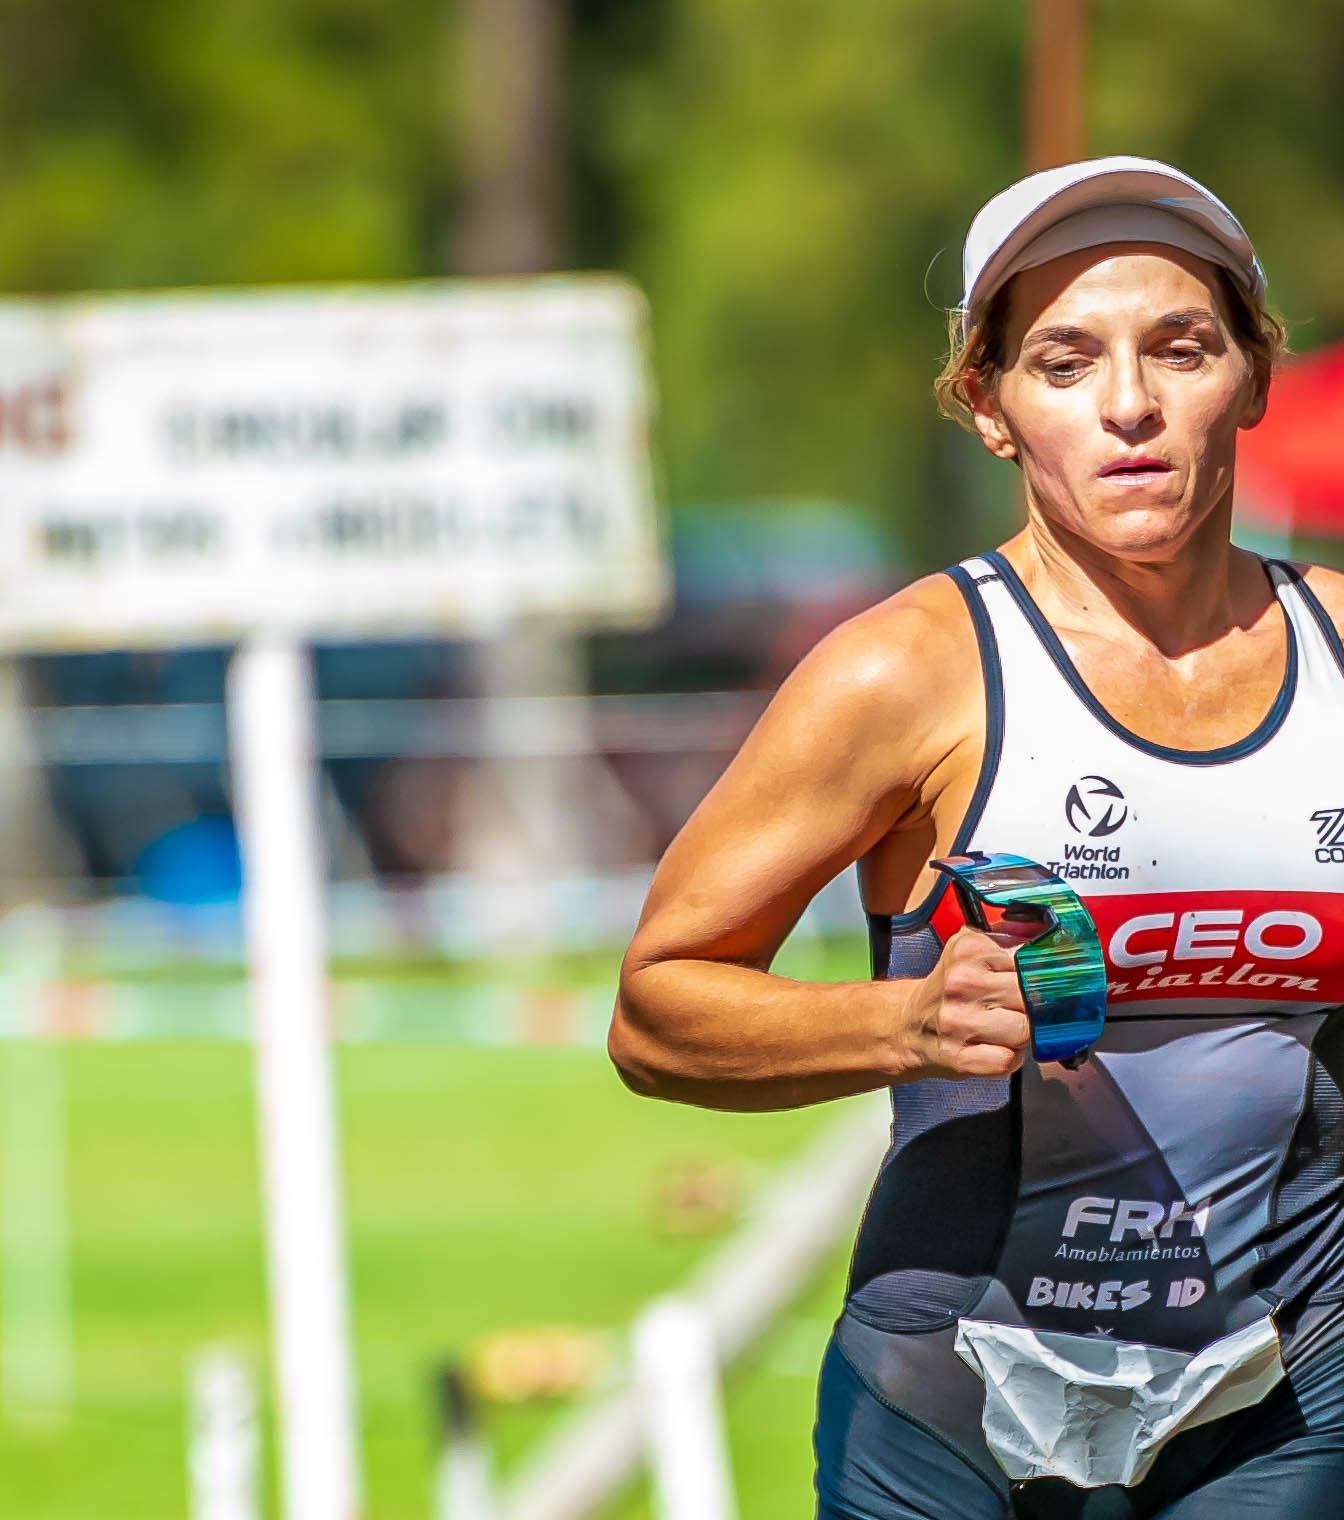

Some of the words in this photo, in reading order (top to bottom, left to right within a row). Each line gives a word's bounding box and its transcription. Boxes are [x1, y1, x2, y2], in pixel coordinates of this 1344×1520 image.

[1064, 843, 1120, 862] World
[1108, 910, 1323, 968] CEO
[1055, 1243, 1202, 1262] Amoblamientos
[1026, 1277, 1152, 1312] BIKES
[1166, 1277, 1206, 1307] ID
